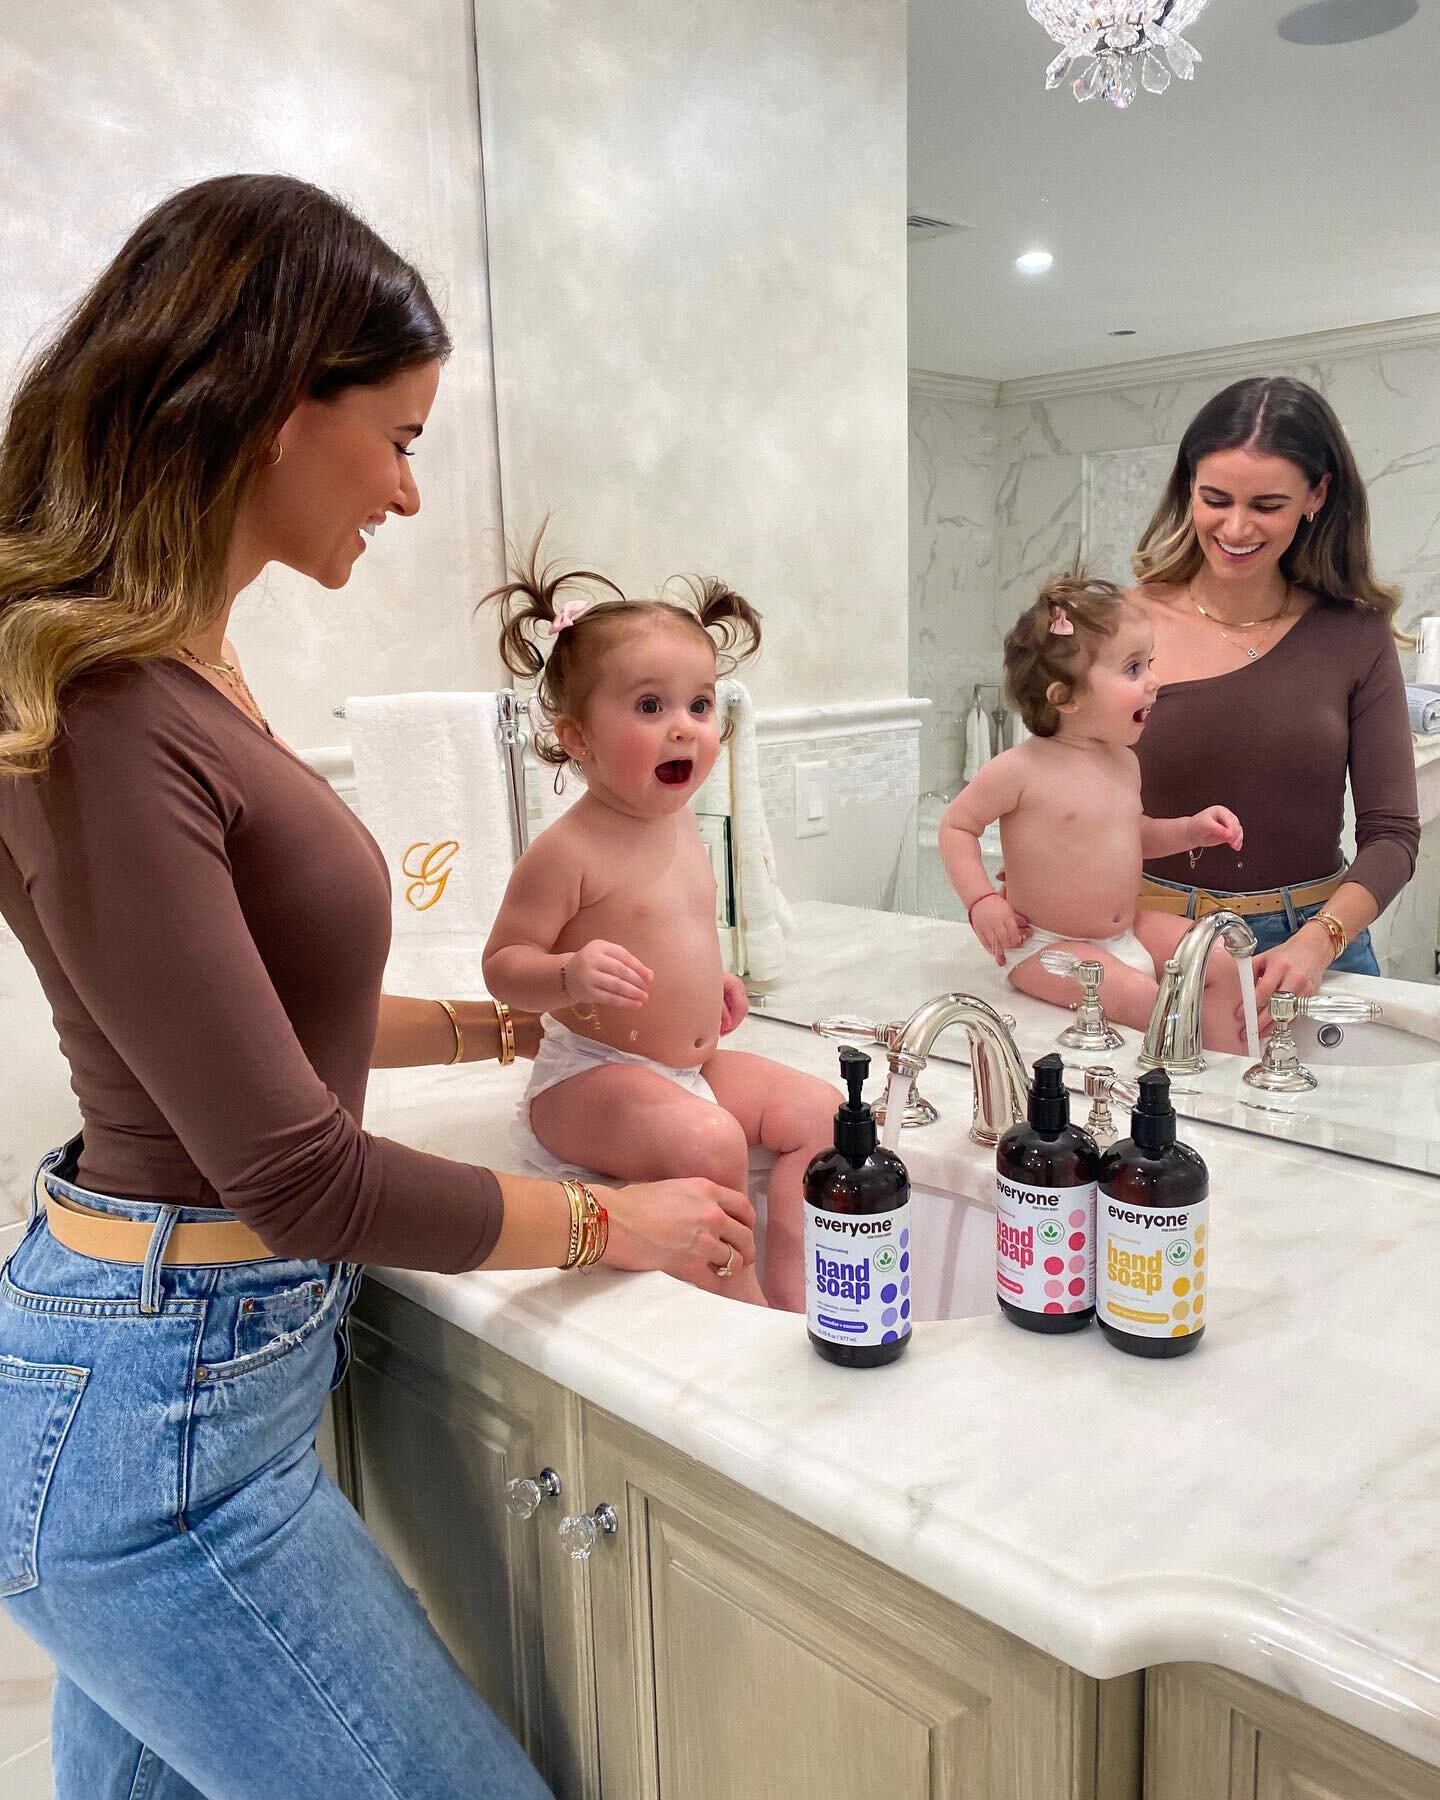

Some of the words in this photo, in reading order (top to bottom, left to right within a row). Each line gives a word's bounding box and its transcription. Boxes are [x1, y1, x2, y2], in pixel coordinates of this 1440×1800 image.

[402, 840, 460, 911] G
[815, 1216, 892, 1237] everyone
[1108, 1205, 1188, 1229] everyone
[815, 1250, 870, 1282] hand
[1107, 1238, 1162, 1274] hand
[816, 1274, 871, 1305] soap
[1107, 1263, 1162, 1296] soap
